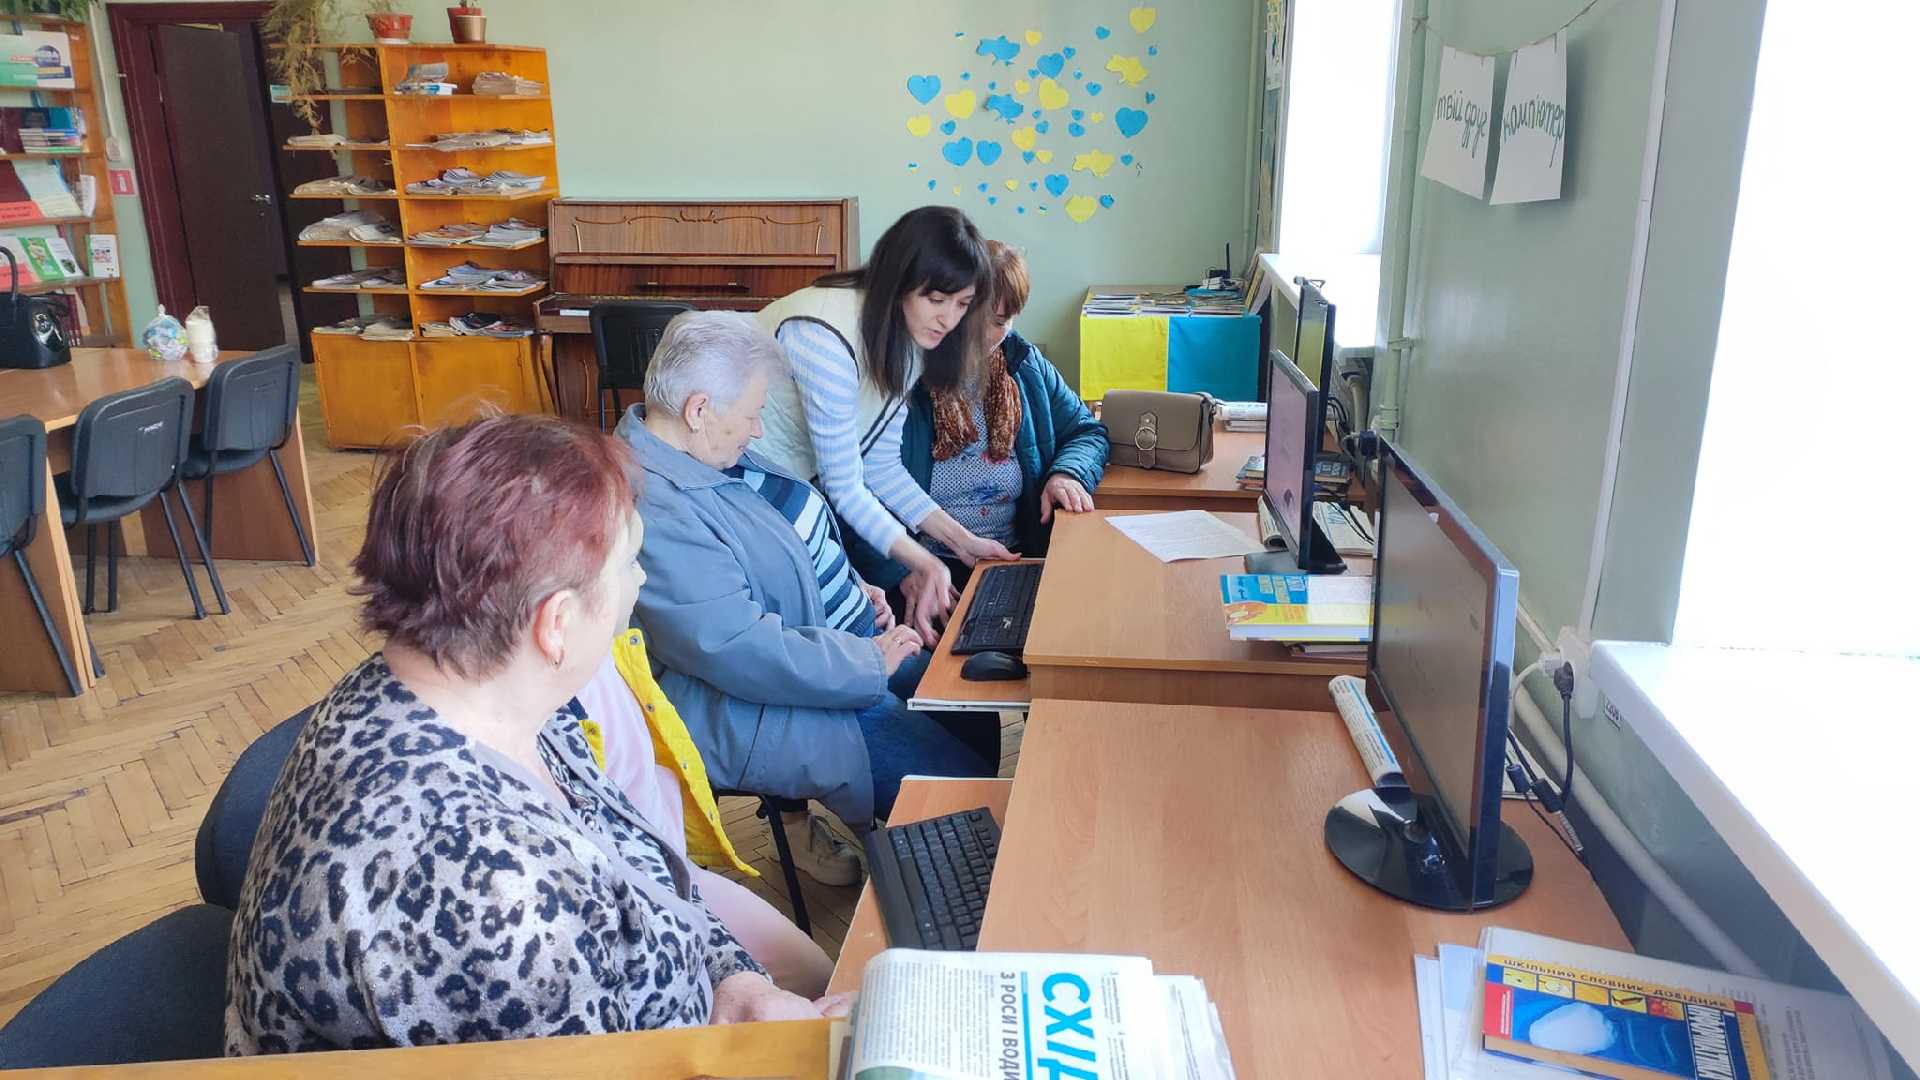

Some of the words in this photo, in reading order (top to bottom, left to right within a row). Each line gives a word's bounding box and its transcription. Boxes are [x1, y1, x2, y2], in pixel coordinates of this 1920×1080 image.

[1461, 100, 1488, 160] друг
[1000, 971, 1016, 980] З
[1000, 984, 1018, 1025] РОСИ
